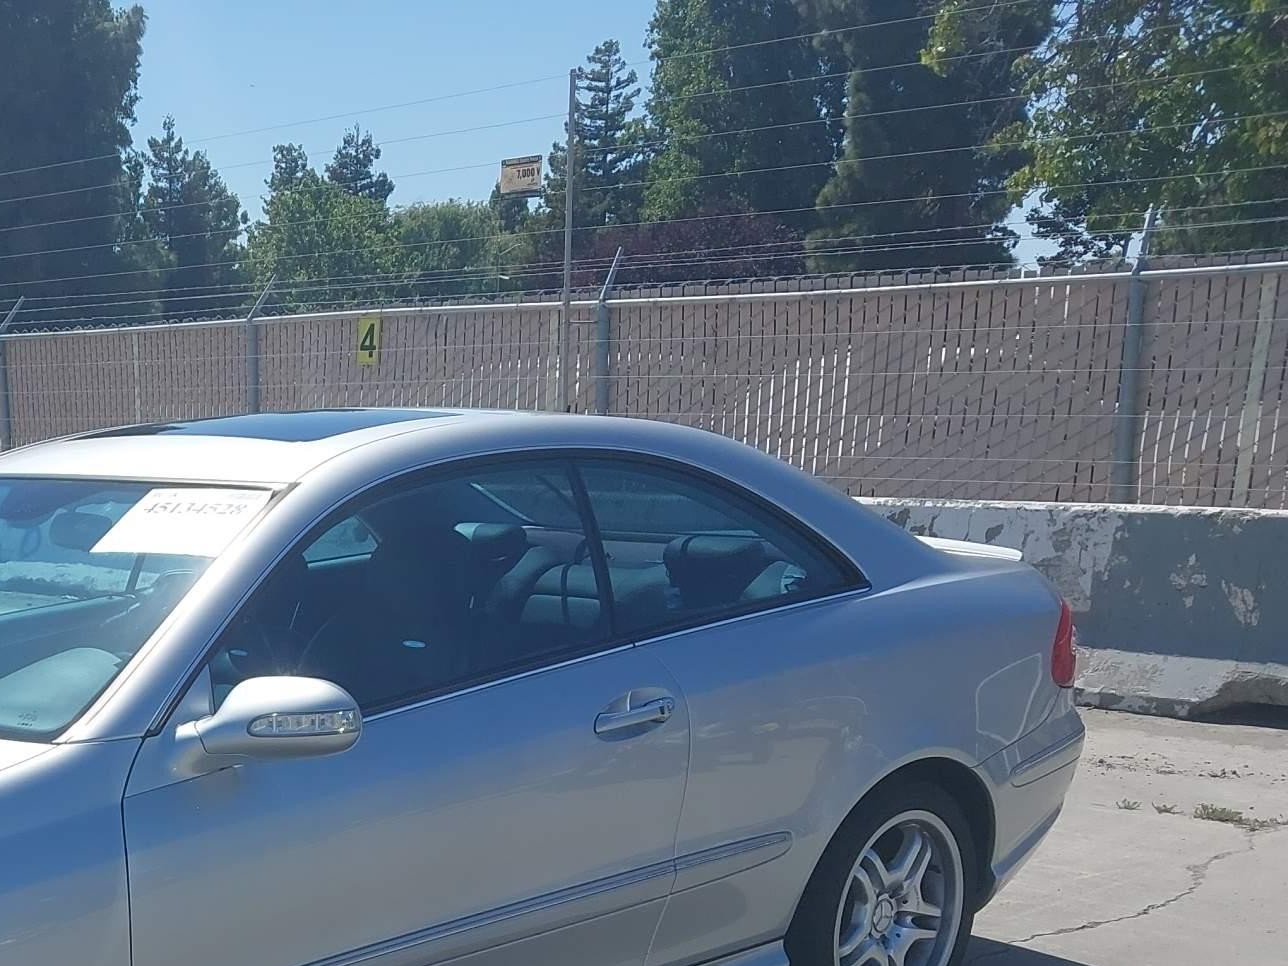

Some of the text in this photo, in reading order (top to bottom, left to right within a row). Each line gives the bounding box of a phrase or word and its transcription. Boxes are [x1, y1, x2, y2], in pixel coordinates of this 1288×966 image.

[516, 168, 535, 180] 7,000
[359, 323, 376, 358] 4
[144, 502, 248, 515] 45134528
